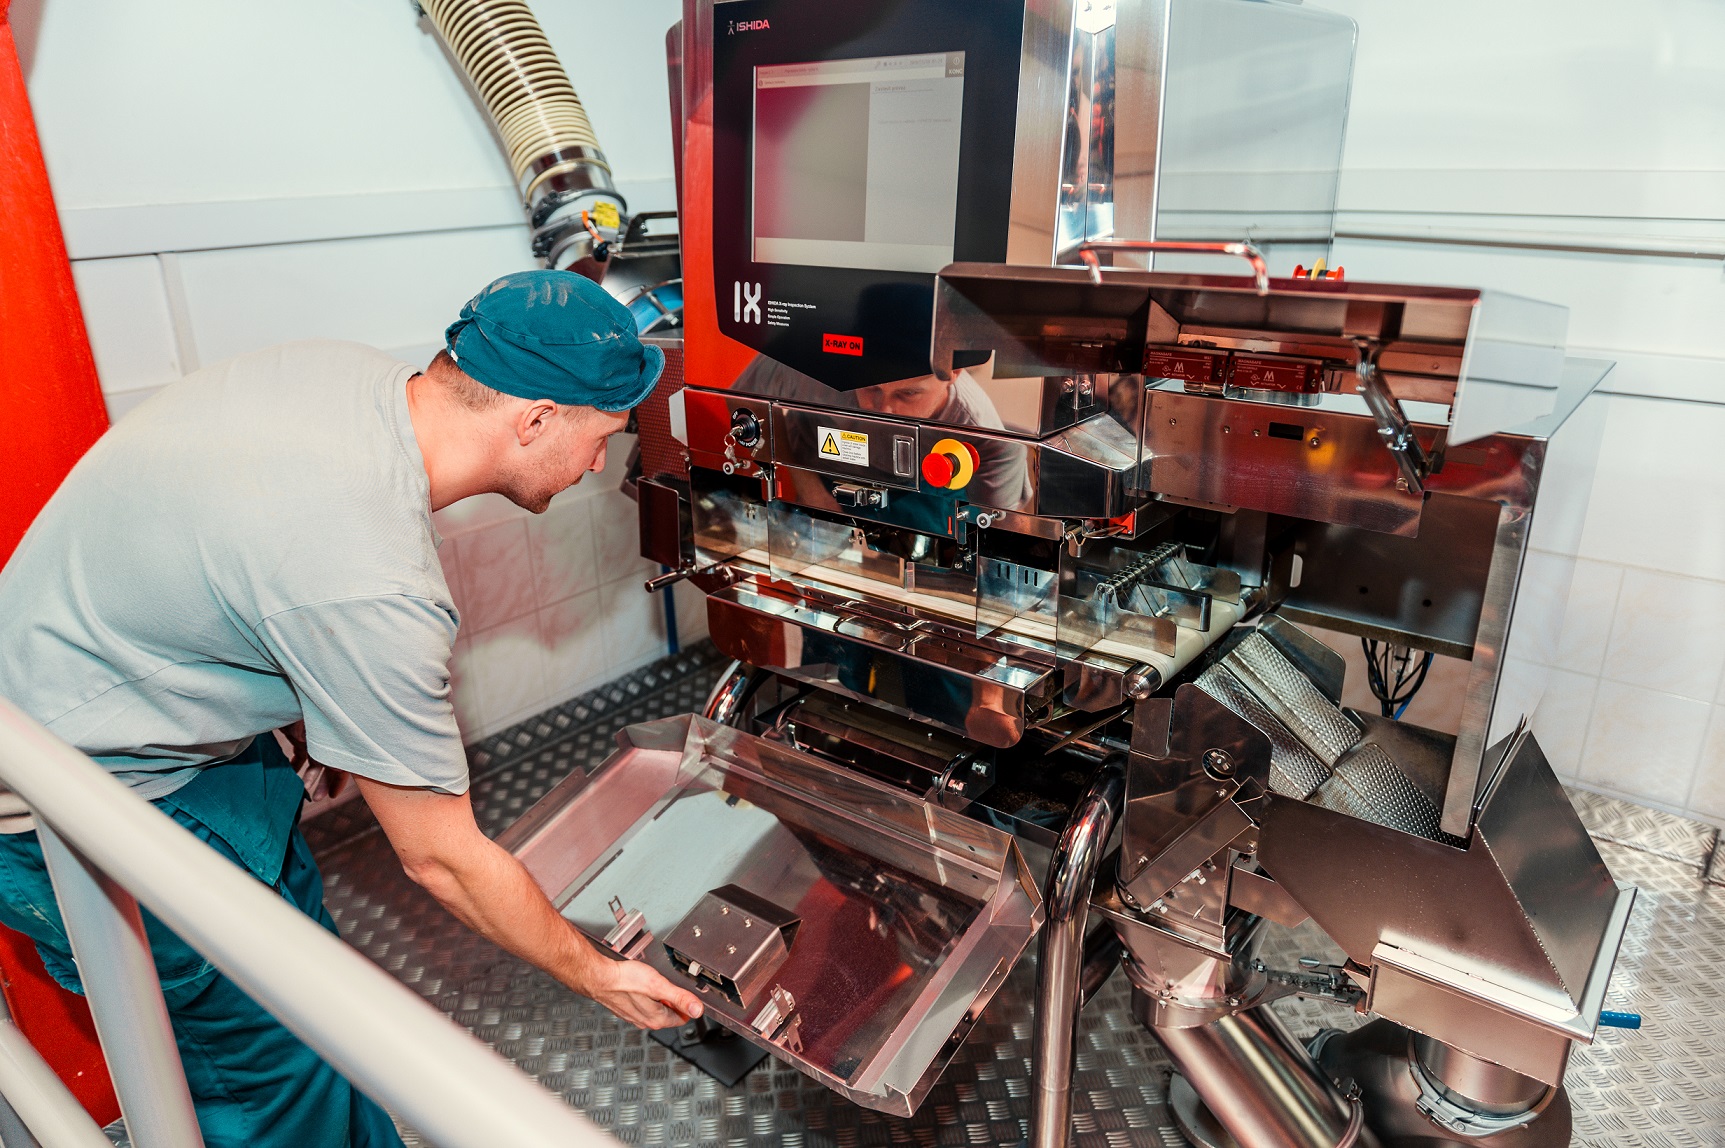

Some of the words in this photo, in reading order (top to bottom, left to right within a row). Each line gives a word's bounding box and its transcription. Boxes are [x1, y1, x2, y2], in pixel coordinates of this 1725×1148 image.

[736, 19, 770, 32] ISHIDA
[734, 280, 762, 325] IX
[825, 339, 848, 349] X-RAY
[849, 341, 861, 350] ON
[750, 413, 757, 422] ON
[847, 434, 866, 442] CAUTION
